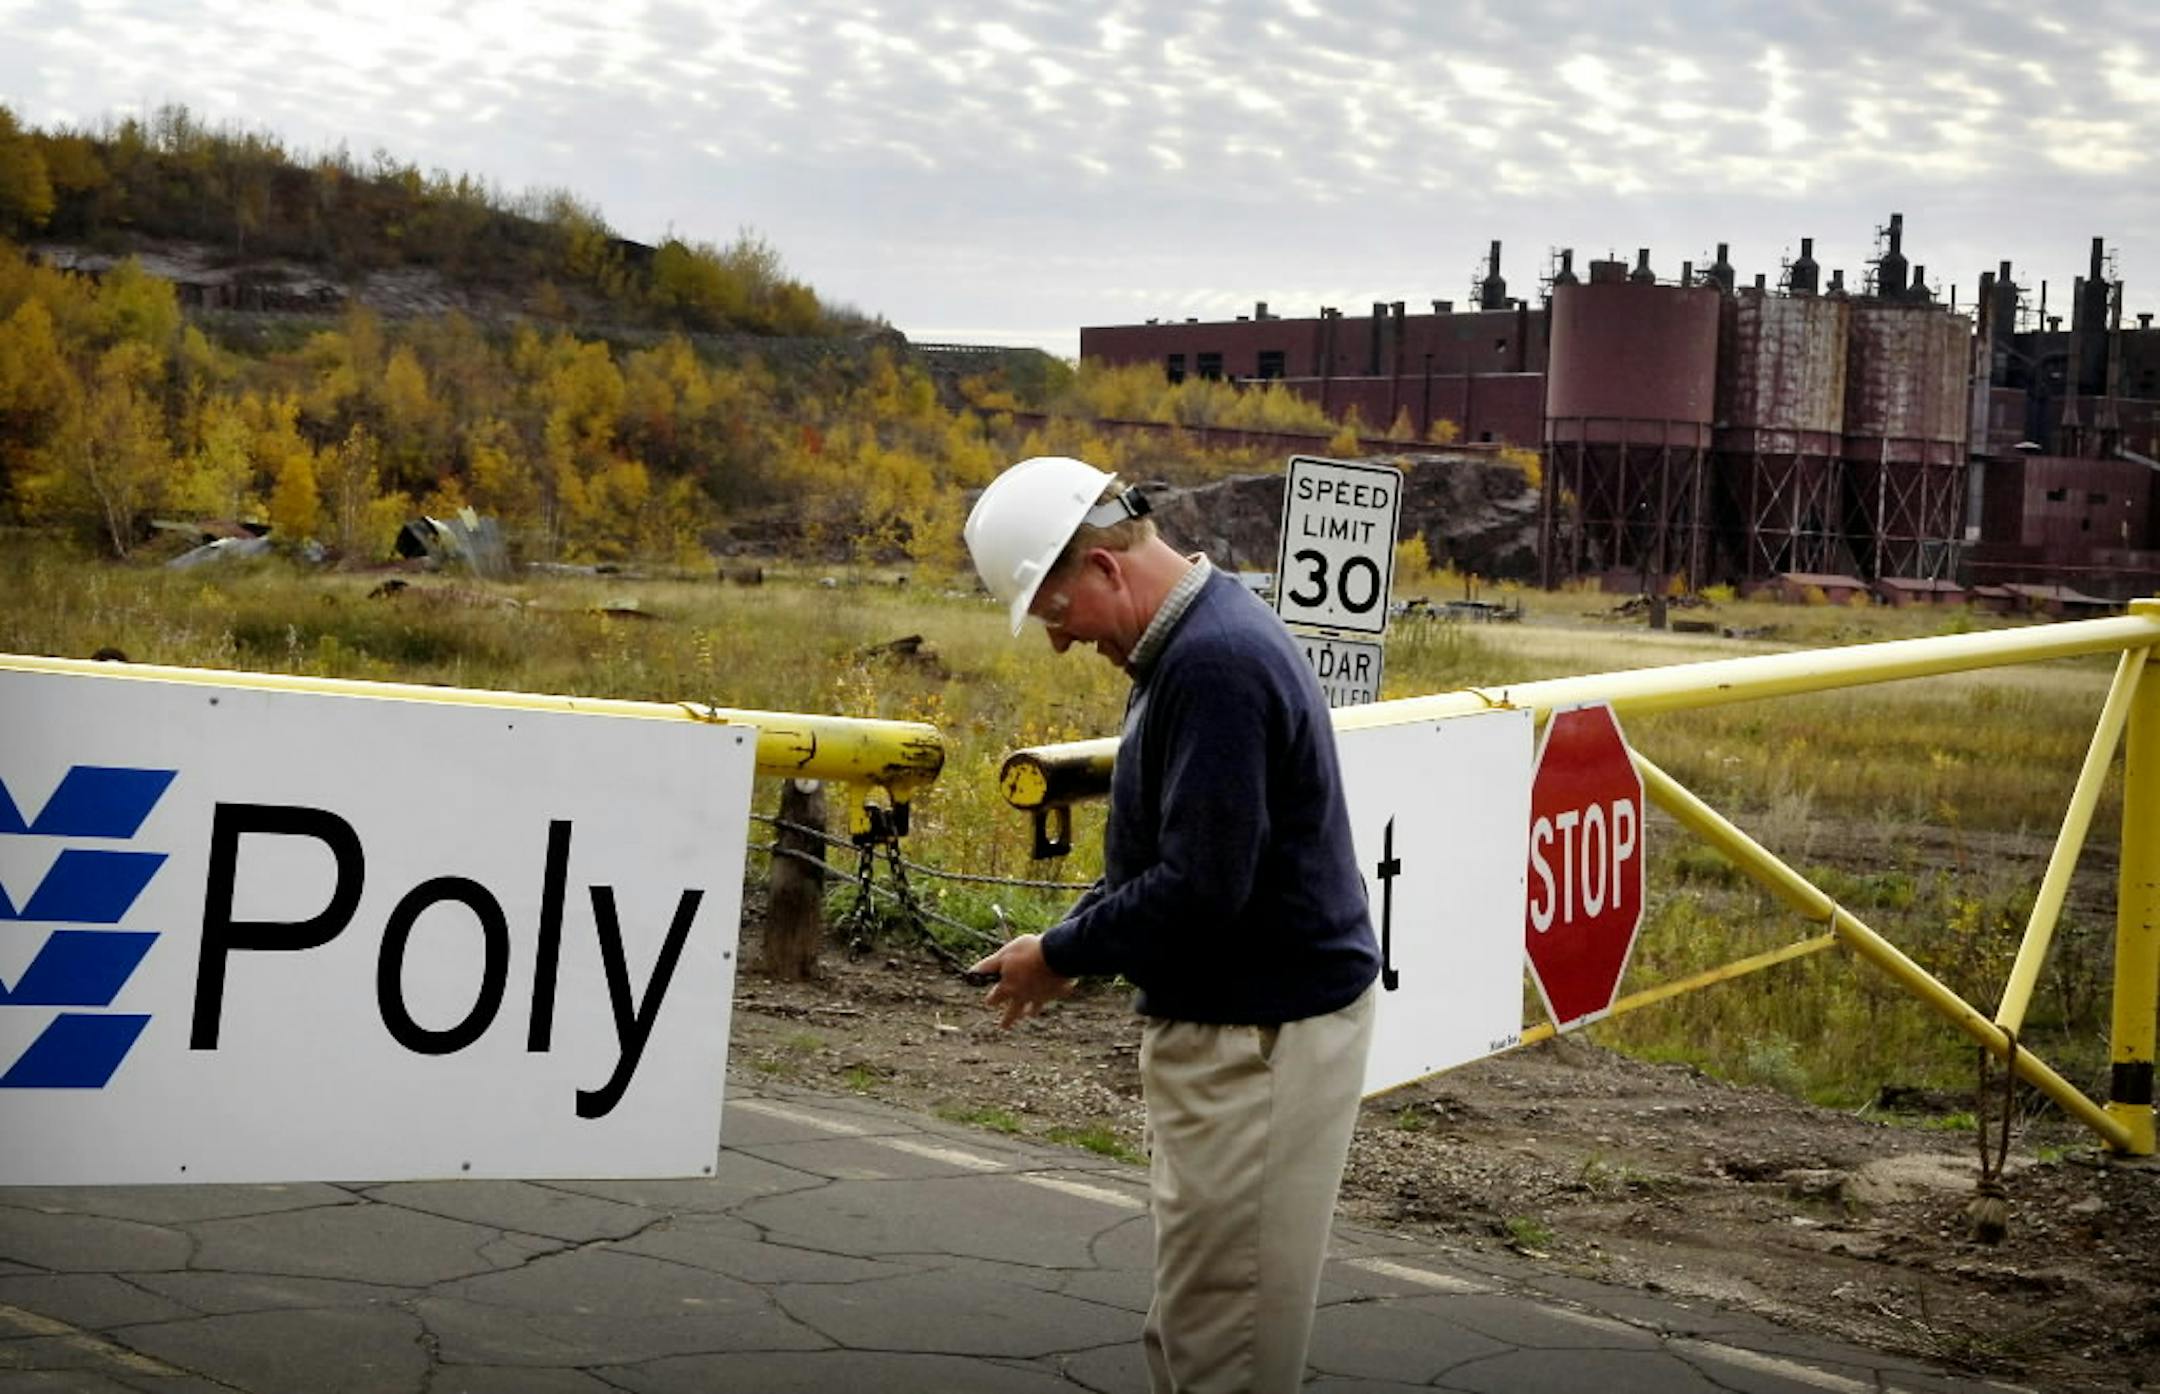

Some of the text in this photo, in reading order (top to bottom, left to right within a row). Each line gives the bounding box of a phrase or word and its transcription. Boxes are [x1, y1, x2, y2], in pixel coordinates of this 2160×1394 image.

[1297, 477, 1388, 509] SPEED
[1303, 514, 1375, 544] LIMIT
[1288, 549, 1380, 614] 30
[1306, 647, 1370, 682] DAR
[1530, 798, 1636, 933] STOP
[1376, 813, 1401, 991] t
[190, 801, 705, 1120] Poly
